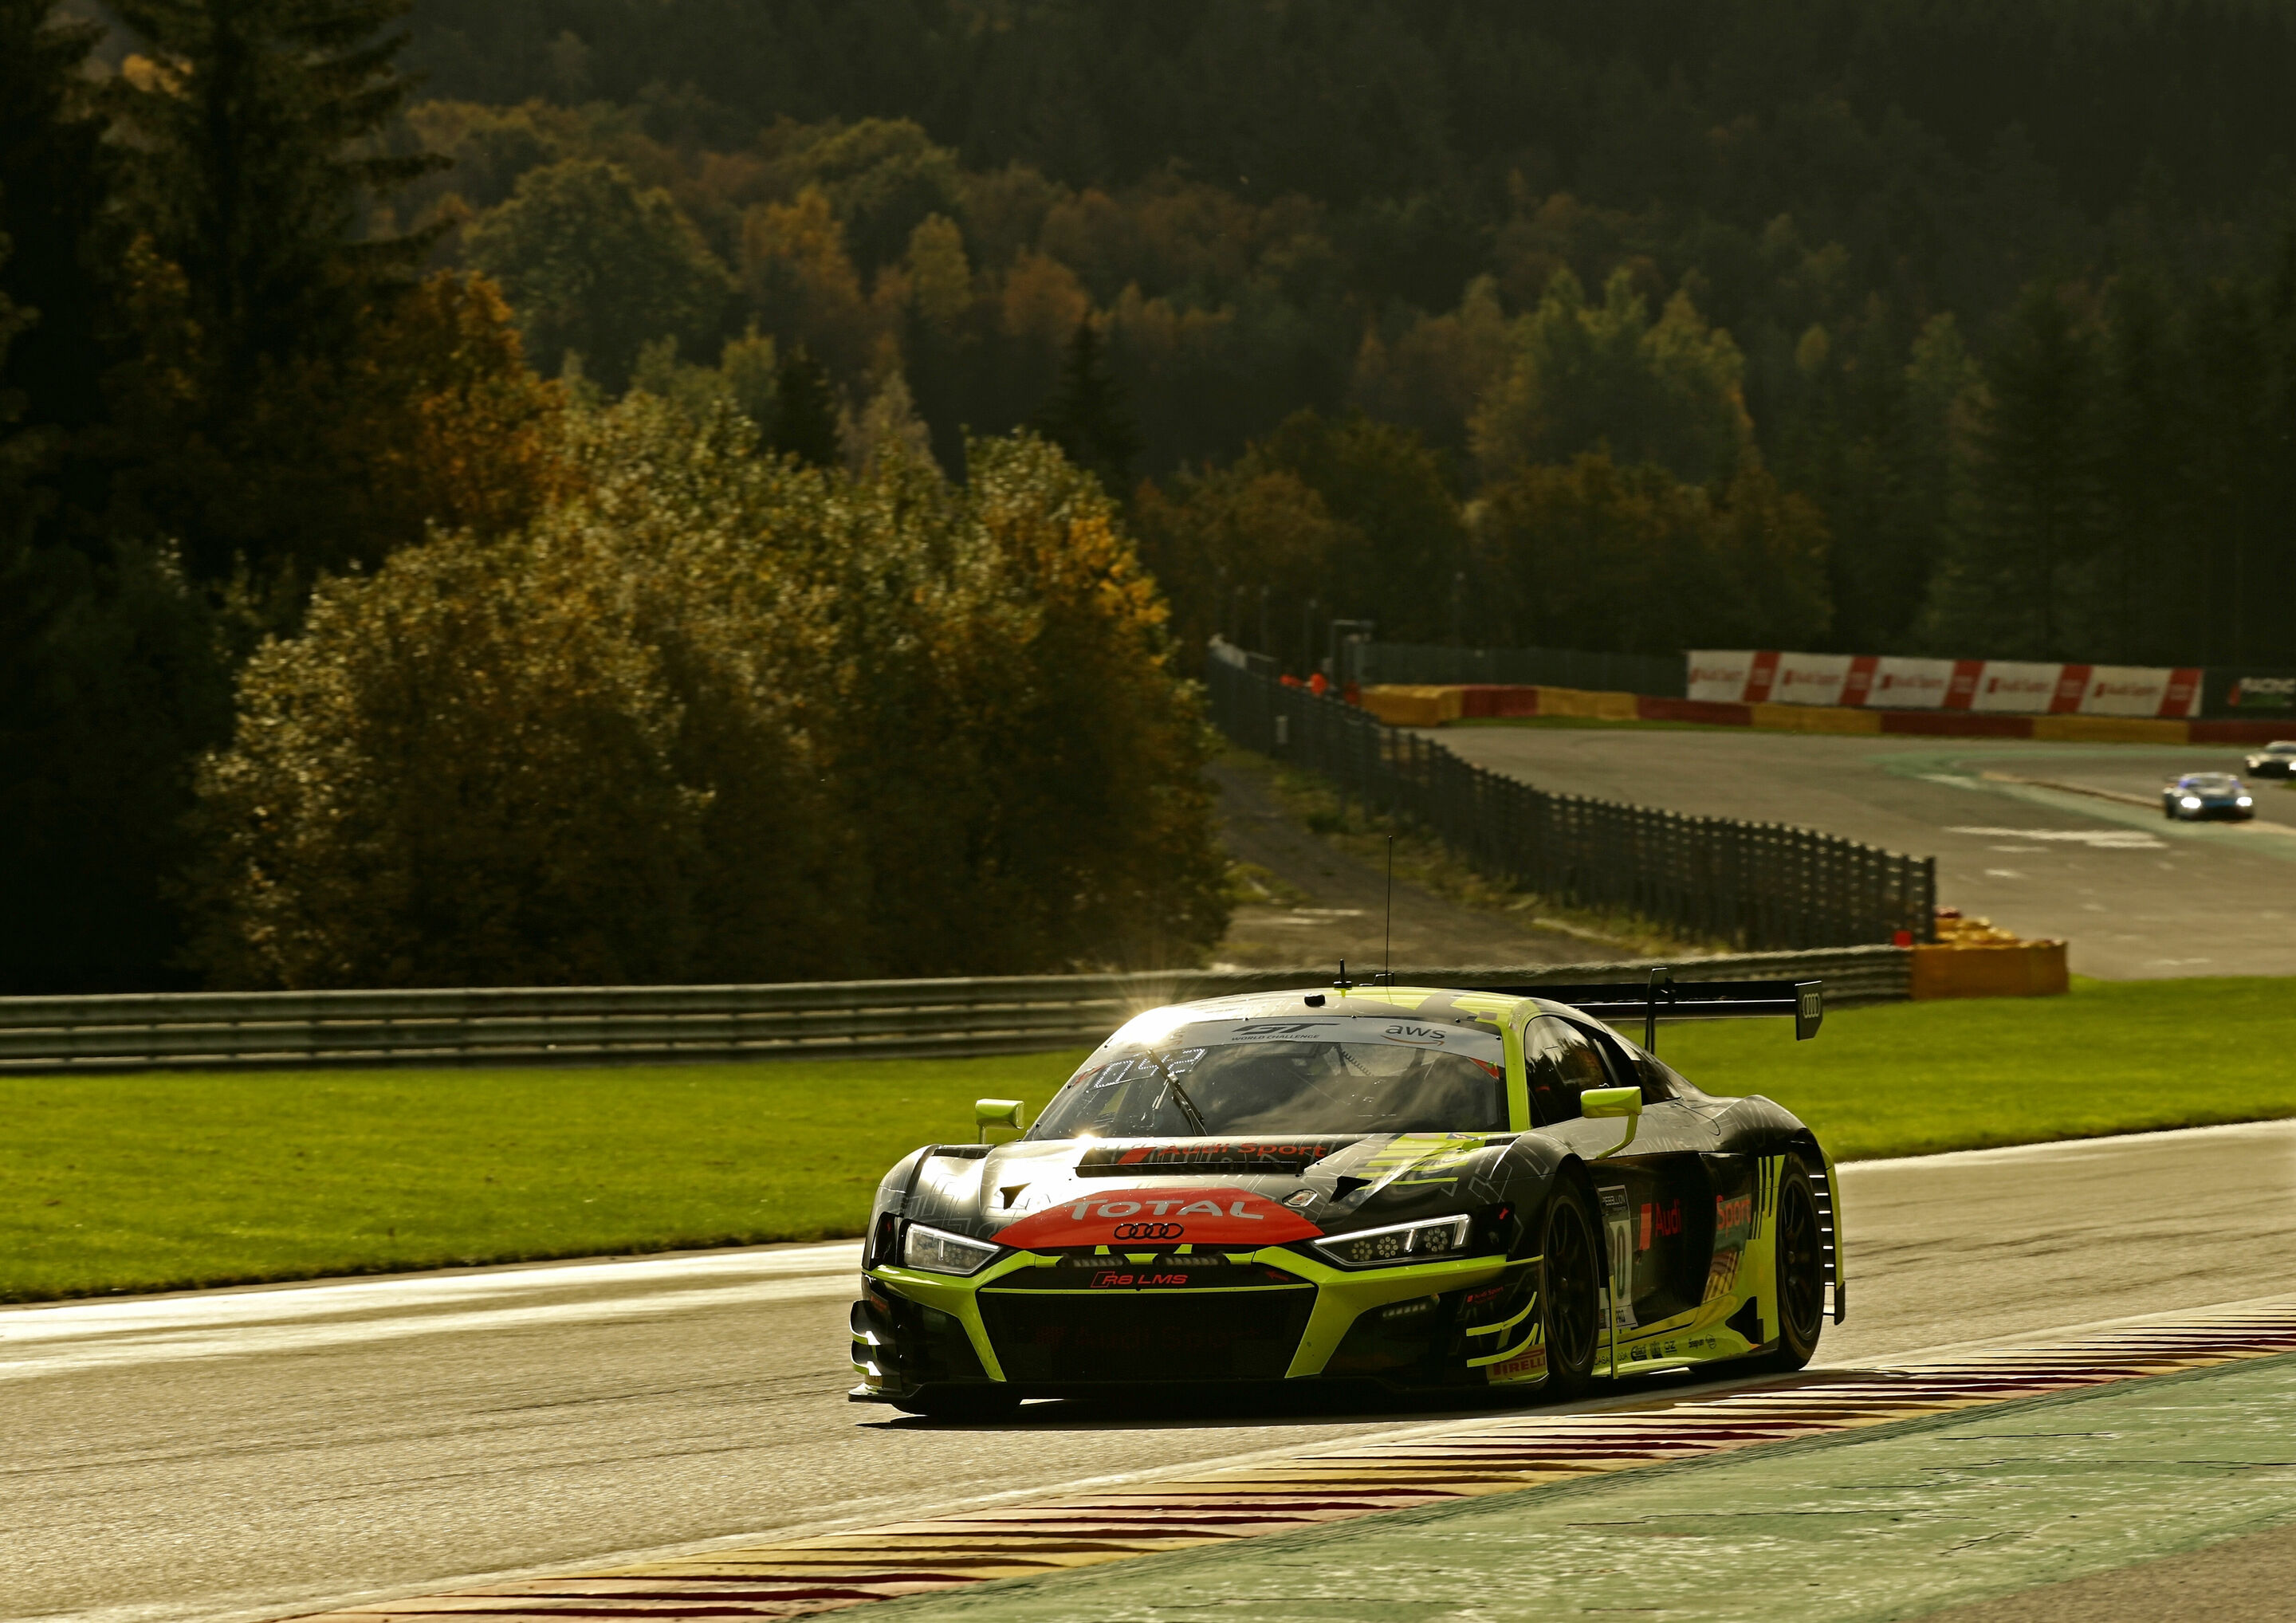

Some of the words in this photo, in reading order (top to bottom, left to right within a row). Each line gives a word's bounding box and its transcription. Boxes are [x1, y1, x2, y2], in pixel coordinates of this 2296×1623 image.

[1232, 1023, 1341, 1034] GT
[1385, 1024, 1447, 1039] aws
[1158, 1143, 1231, 1157] Audi
[1237, 1142, 1330, 1159] Sport
[1067, 1198, 1265, 1220] TOTAL
[1655, 1198, 1682, 1238] Audi
[1716, 1193, 1752, 1238] Sport
[1101, 1273, 1133, 1286] R8
[1137, 1273, 1189, 1285] LMS
[1492, 1349, 1547, 1376] PIRELLI
